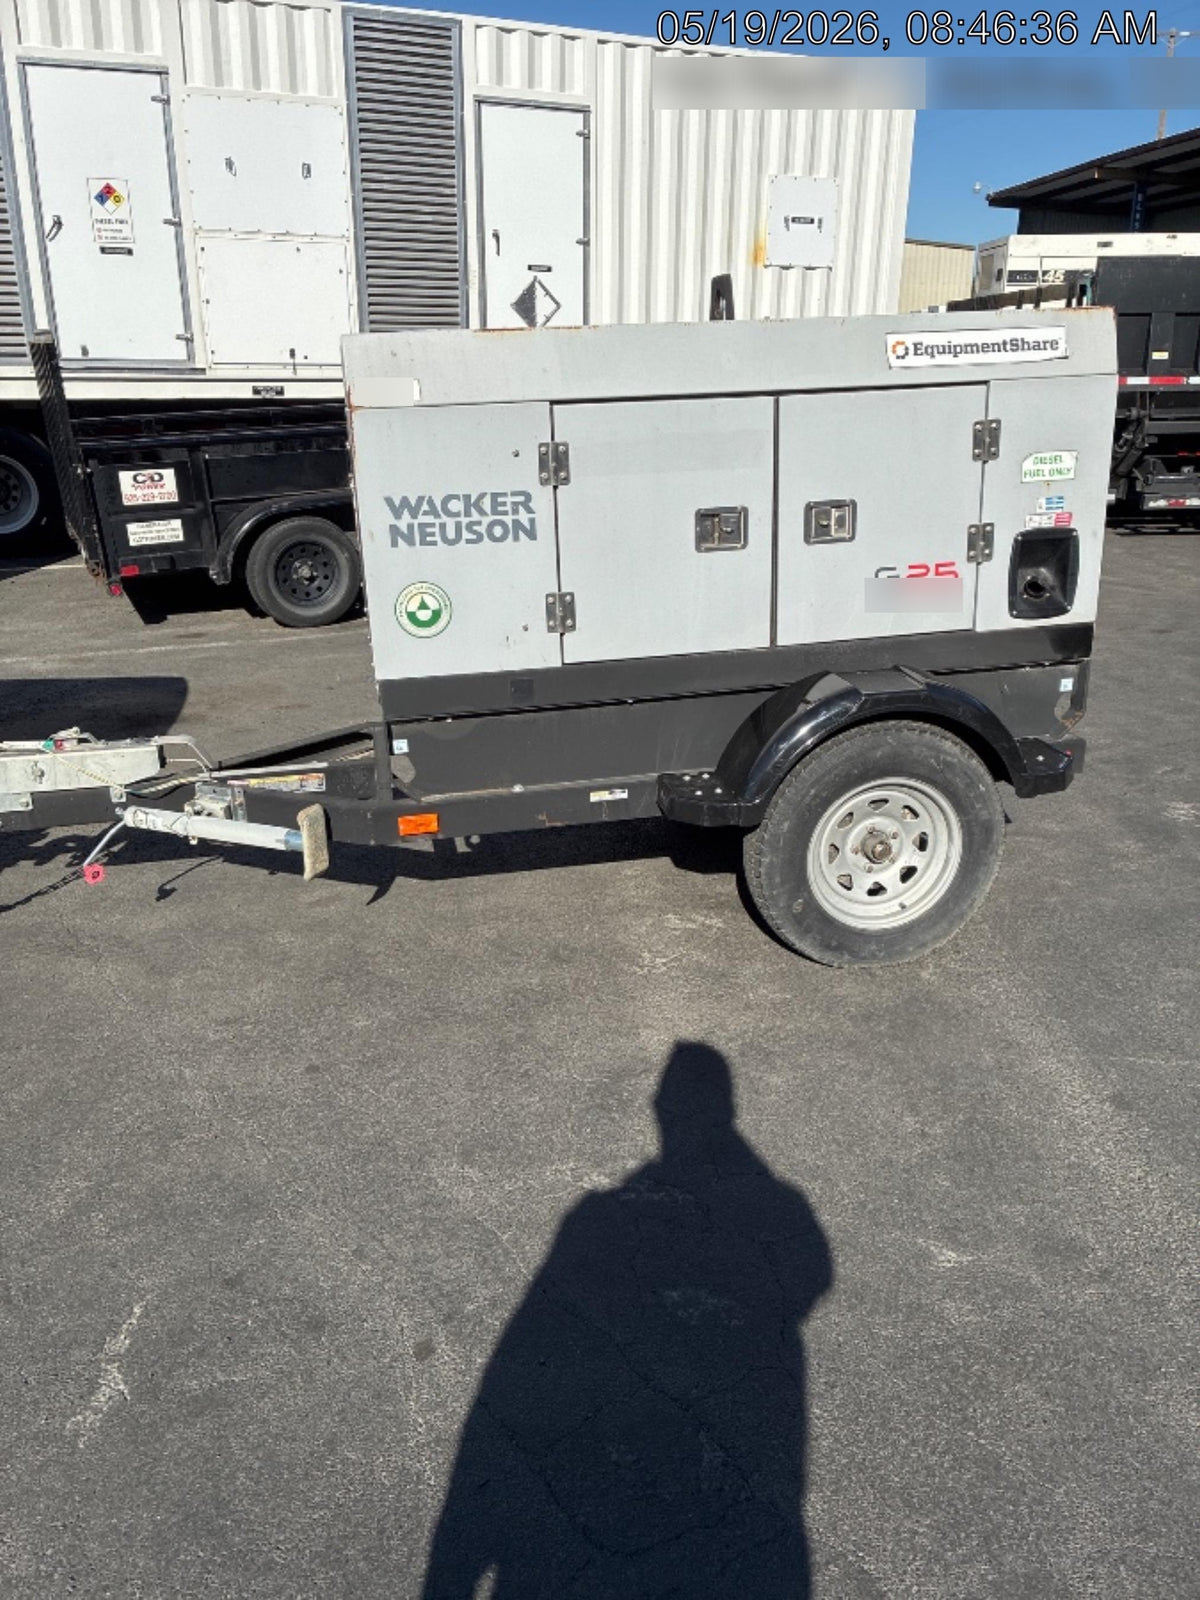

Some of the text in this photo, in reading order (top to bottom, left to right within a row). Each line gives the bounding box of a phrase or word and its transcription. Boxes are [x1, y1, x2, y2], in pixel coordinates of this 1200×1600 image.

[912, 337, 1059, 358] EquipmentShare
[1032, 454, 1063, 466] DIESEL
[1023, 466, 1073, 479] FUEL ONLY
[383, 490, 536, 520] WACKER
[388, 516, 538, 548] NEUSON
